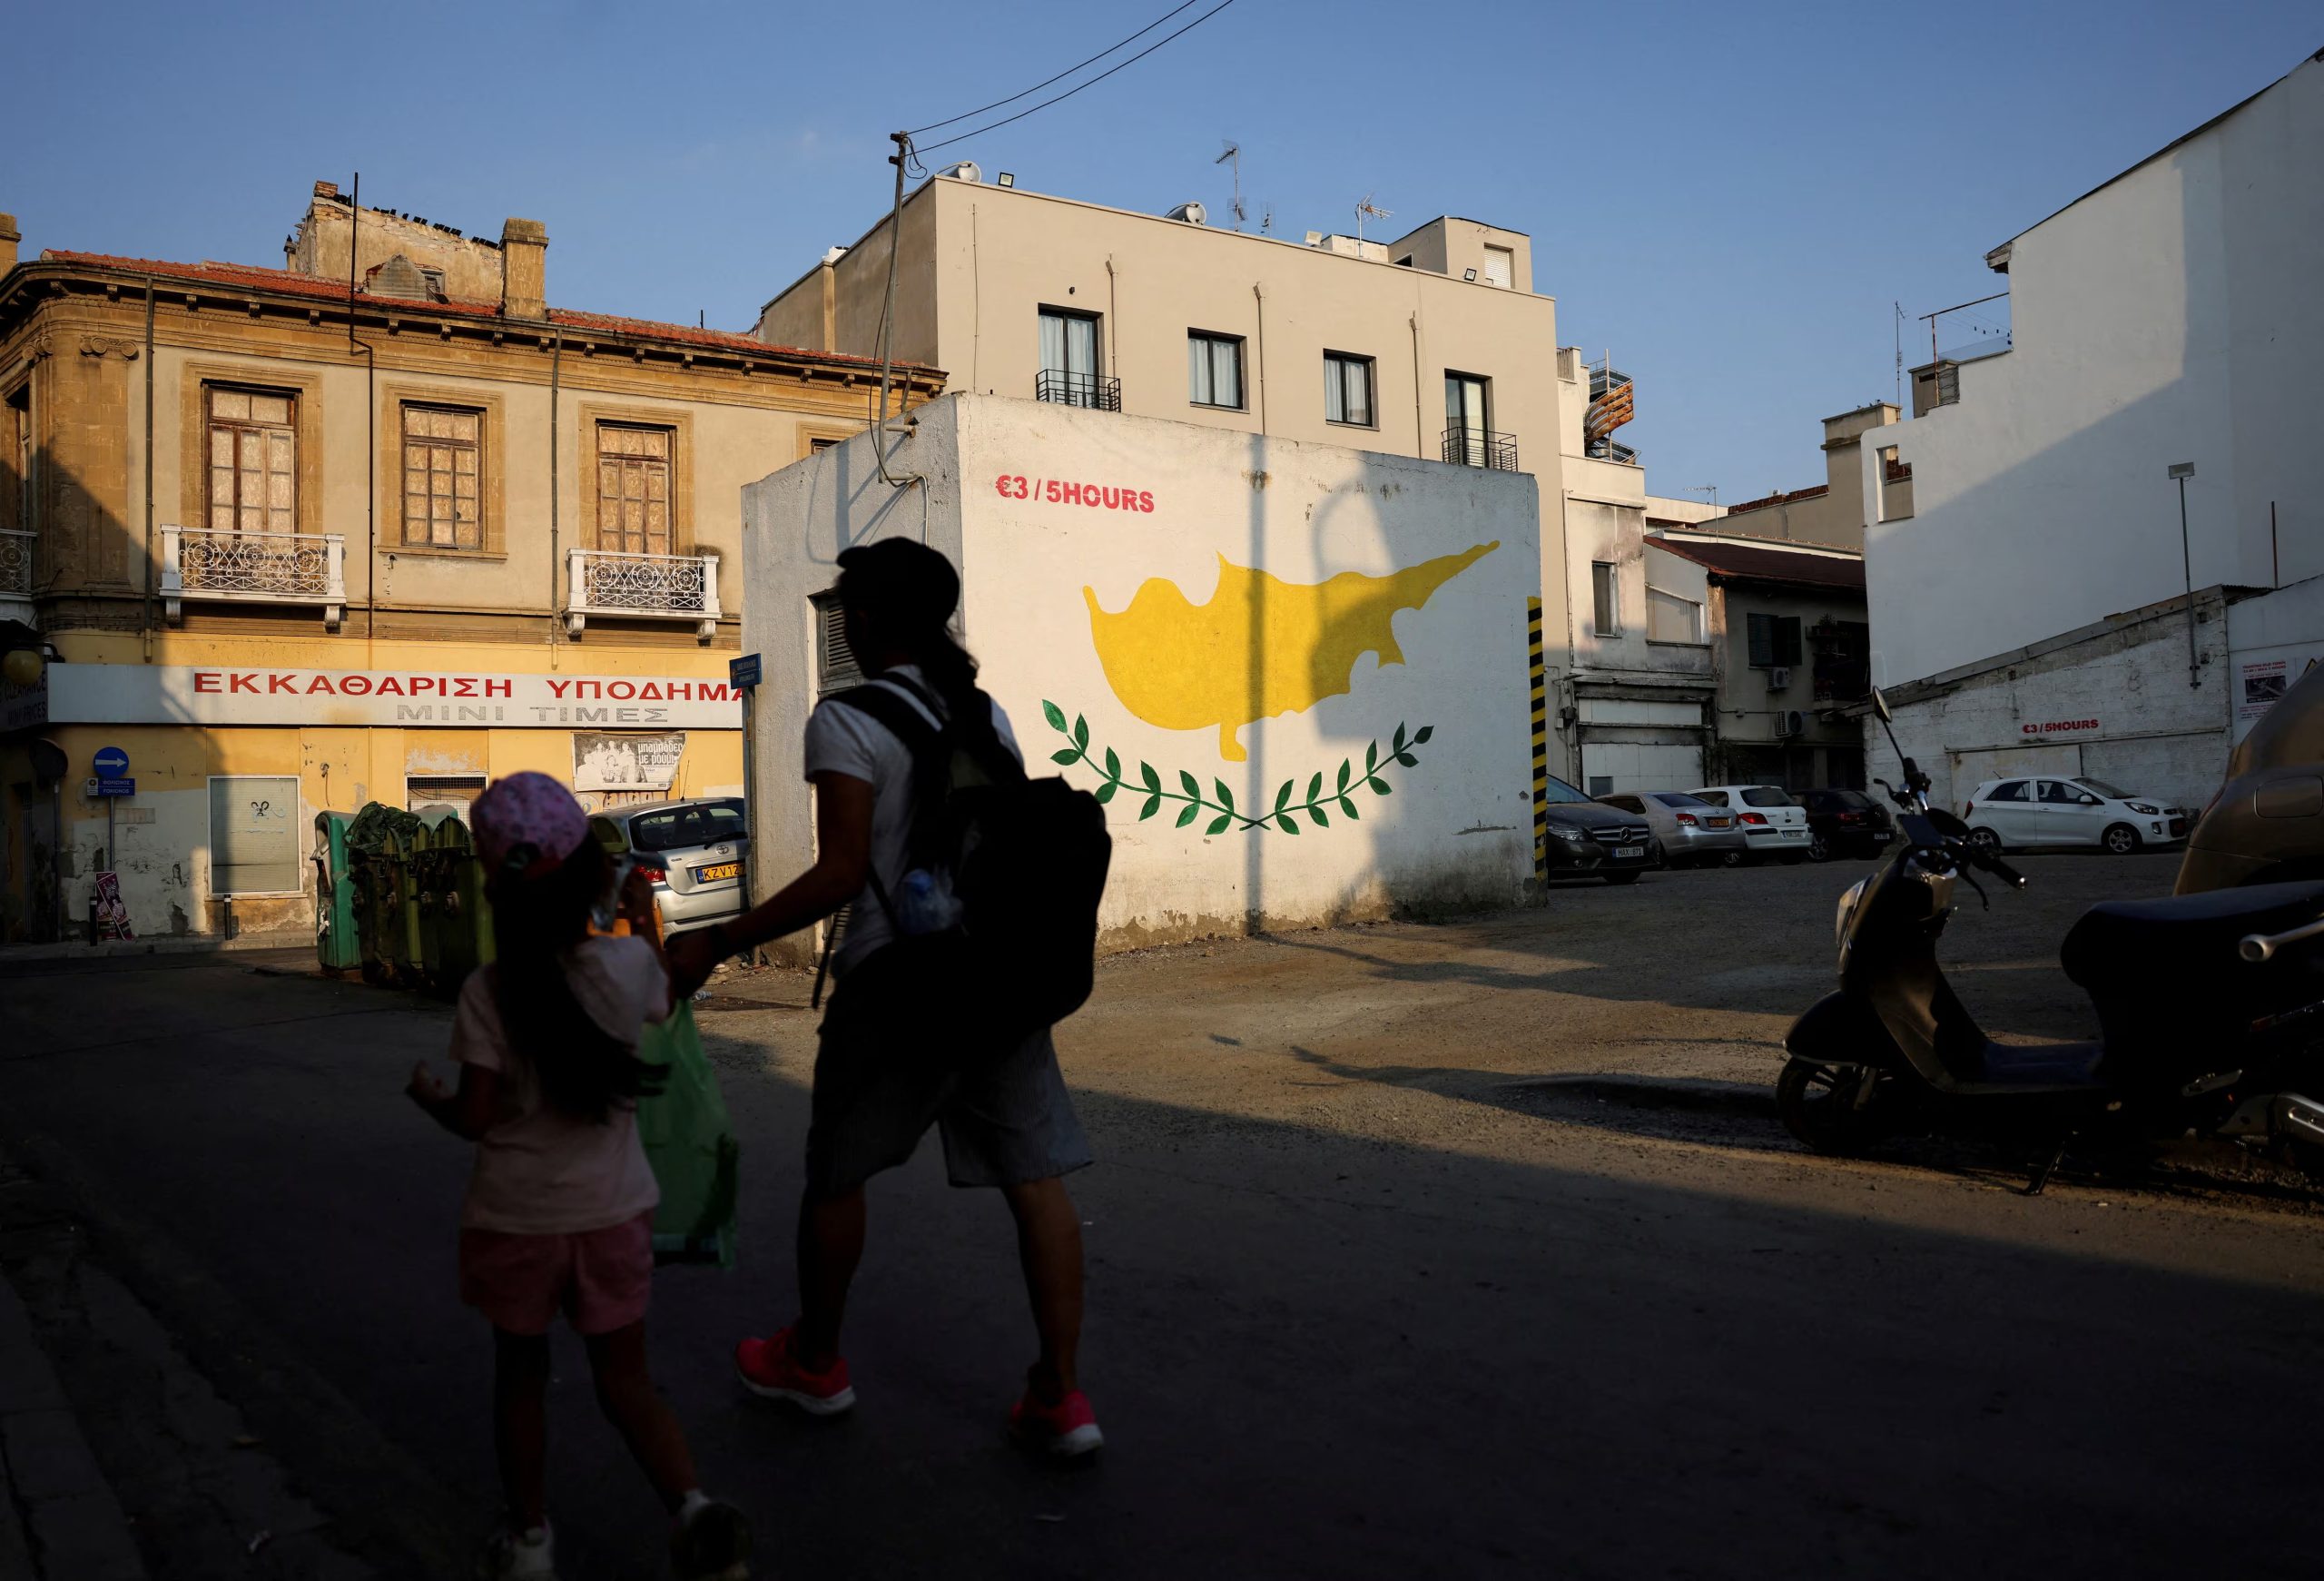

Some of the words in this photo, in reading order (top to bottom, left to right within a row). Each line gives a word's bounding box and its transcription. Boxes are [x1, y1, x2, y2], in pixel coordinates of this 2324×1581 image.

[995, 474, 1029, 499] €3
[1033, 479, 1041, 501] /
[1046, 479, 1156, 513] 5HOURS
[193, 672, 512, 697] ΕΚΚΑΘΑΡΙΣΗ
[529, 707, 668, 723] ΤΙΜΕΣ
[2023, 724, 2038, 733] €3
[2044, 719, 2099, 732] 5HOURS
